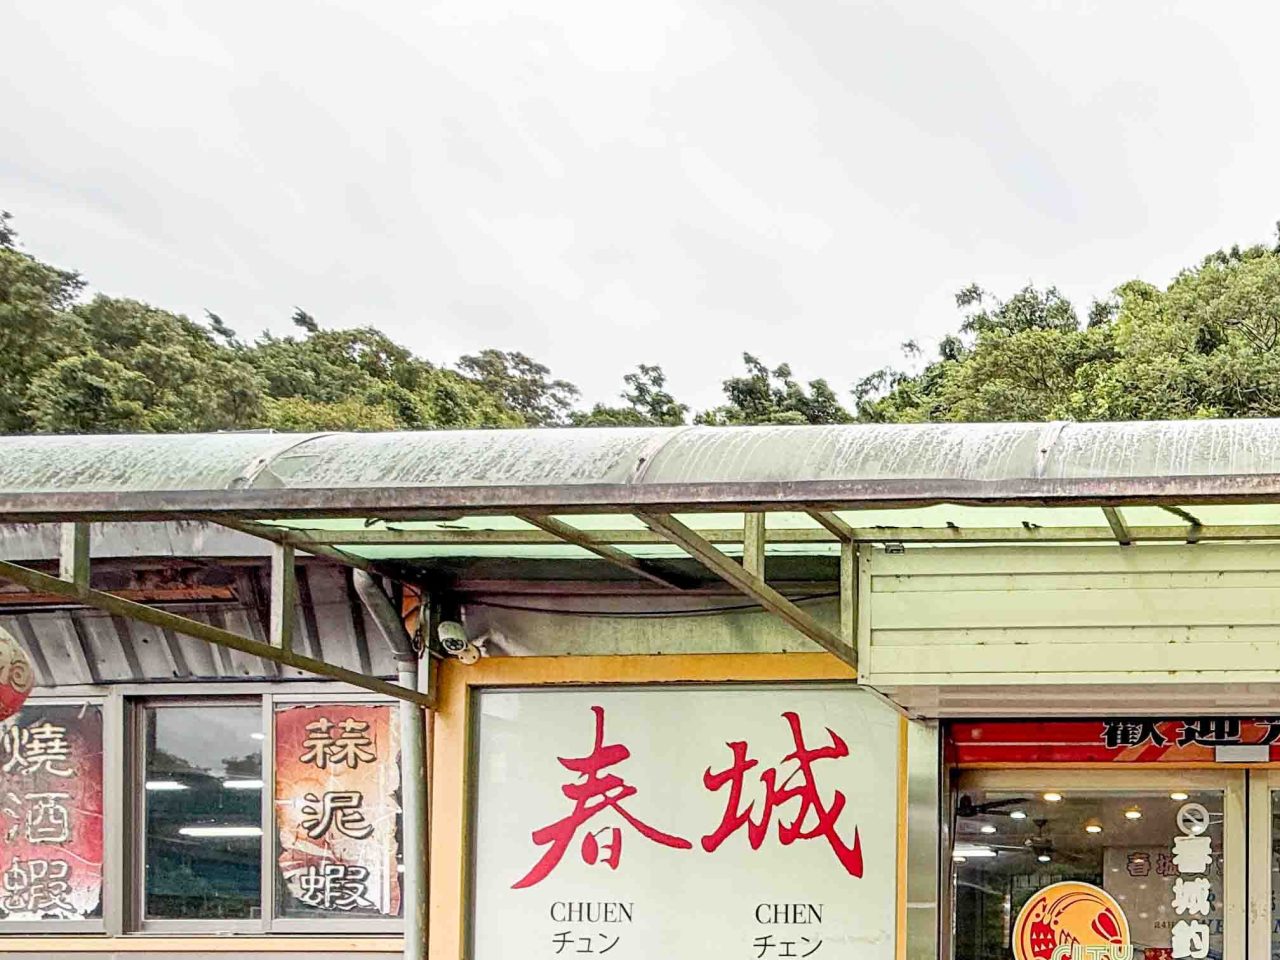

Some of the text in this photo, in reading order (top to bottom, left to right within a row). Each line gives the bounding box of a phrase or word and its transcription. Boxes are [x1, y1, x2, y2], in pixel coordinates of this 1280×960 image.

[2, 721, 74, 917] 燒酒蝦
[300, 716, 376, 911] 蒜泥蝦
[510, 705, 864, 889] 春城
[549, 902, 824, 925] CHUEN CHEN
[552, 929, 824, 958] チュン チェン
